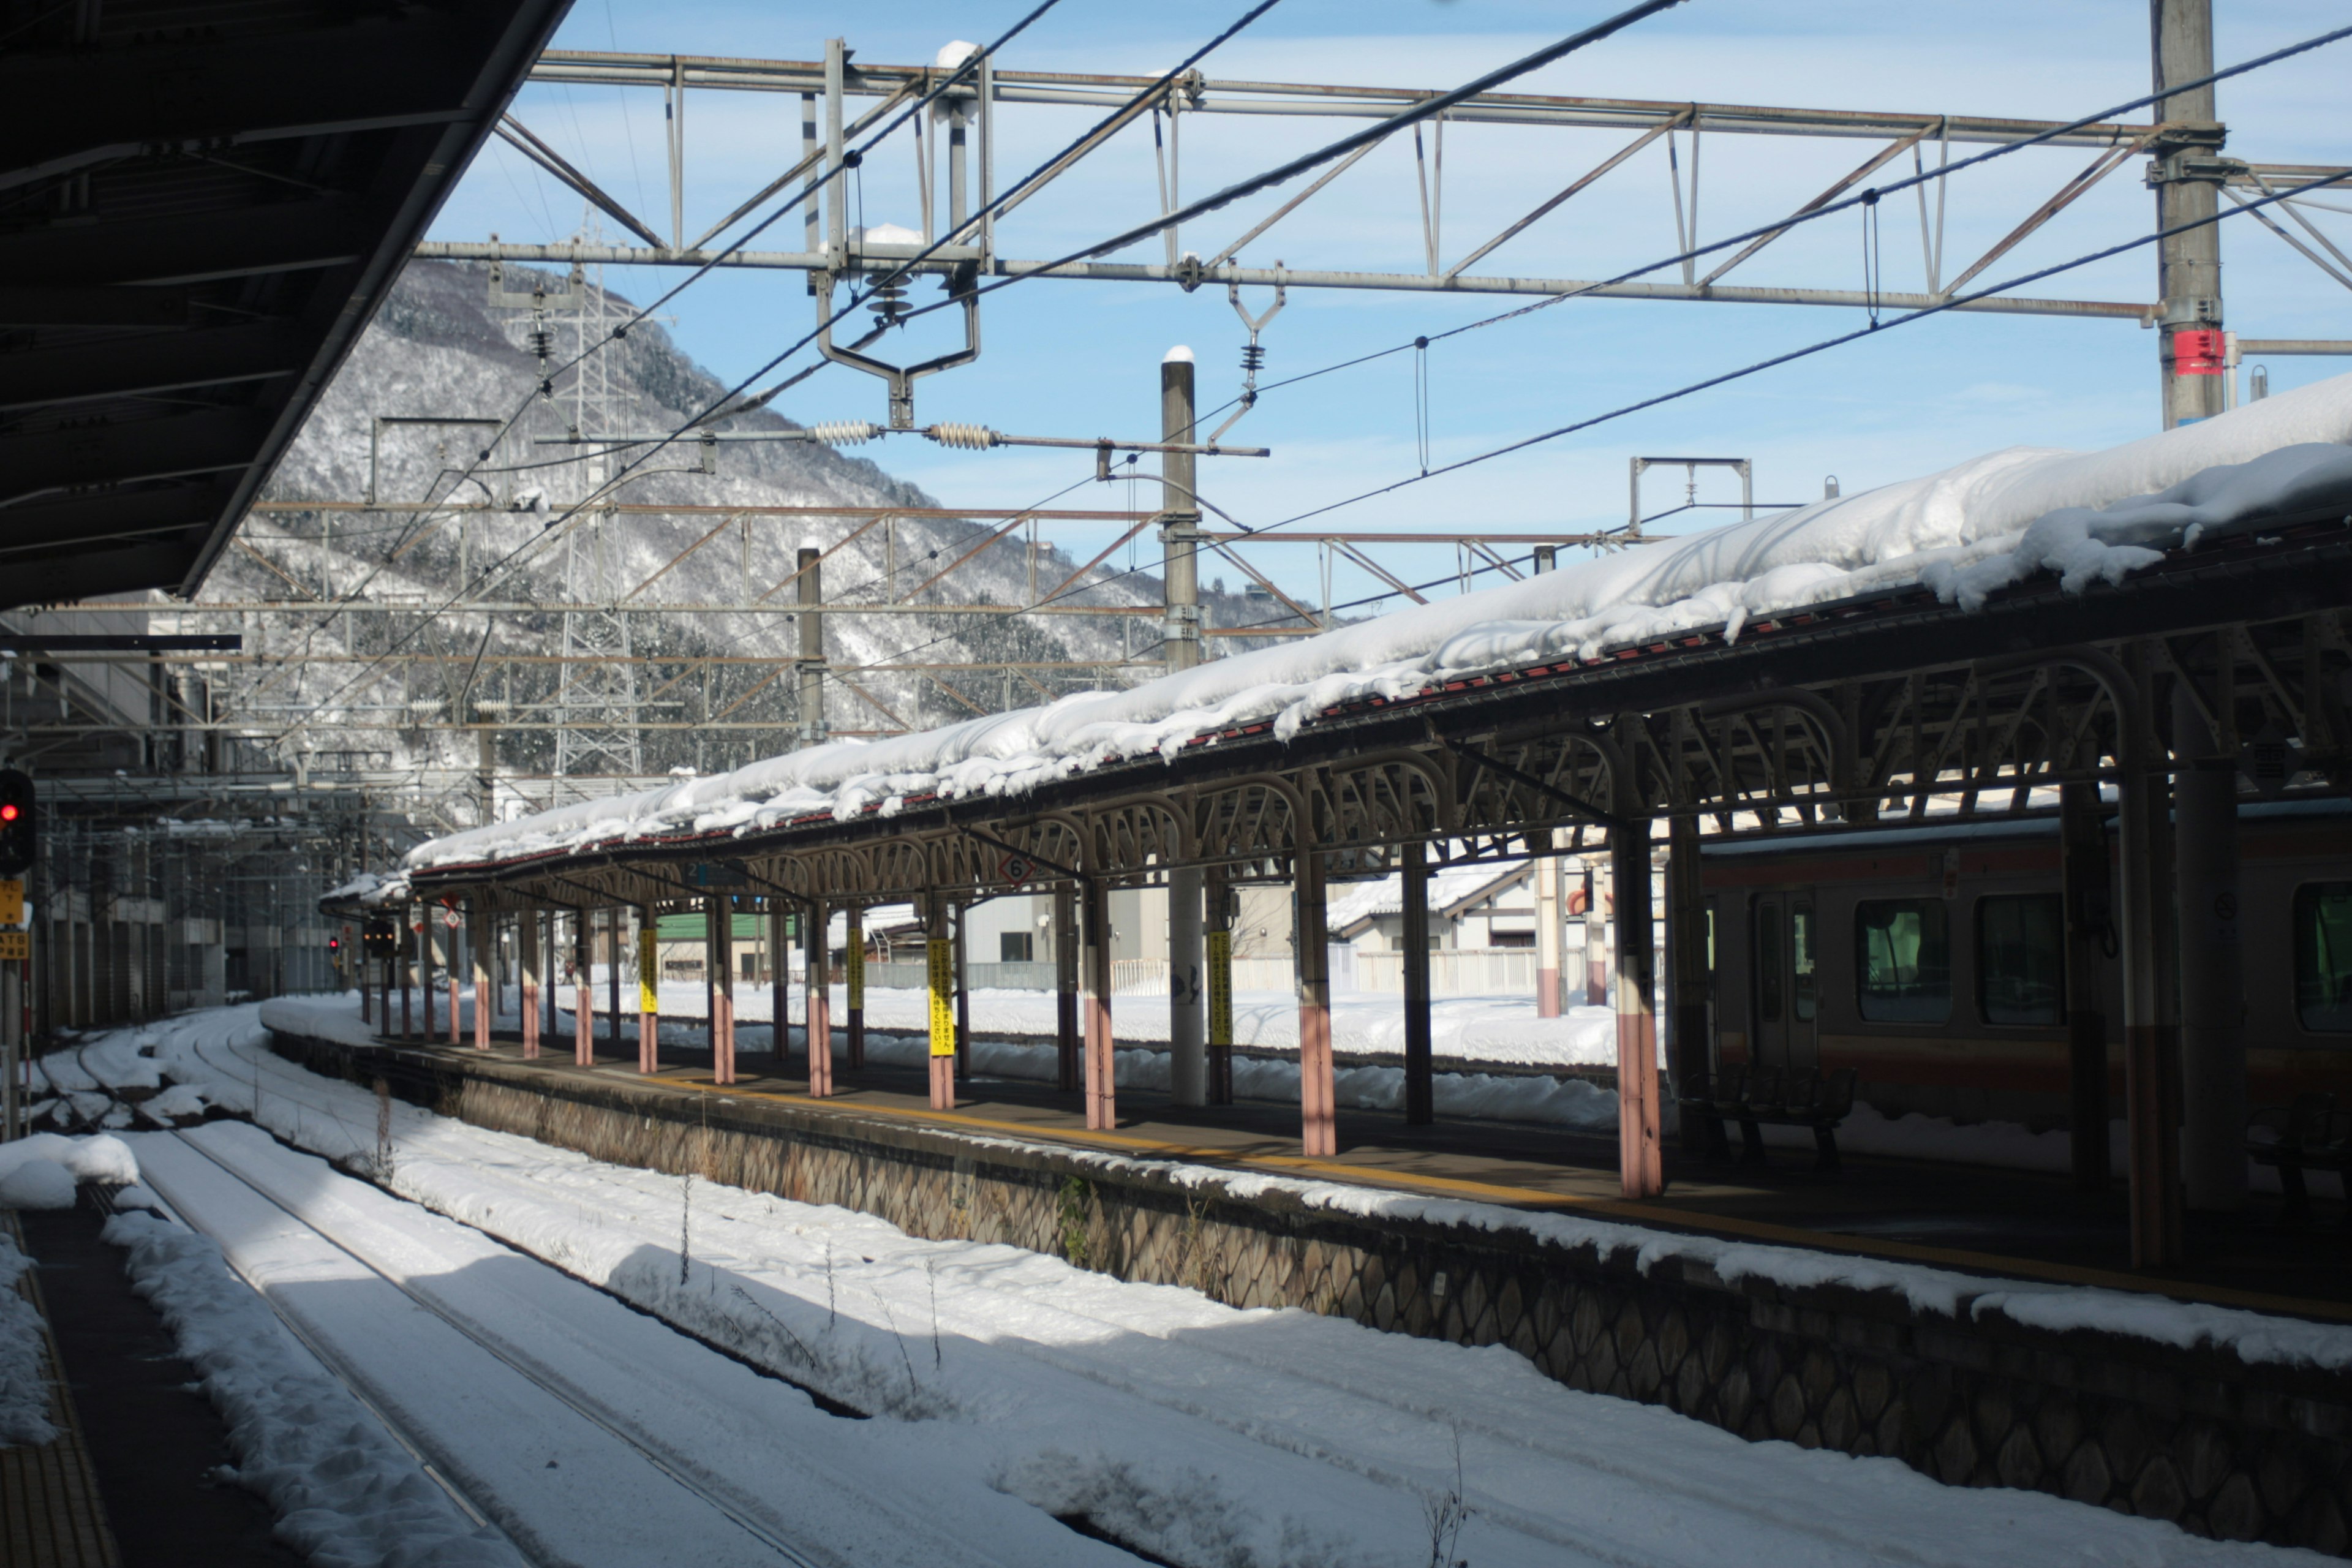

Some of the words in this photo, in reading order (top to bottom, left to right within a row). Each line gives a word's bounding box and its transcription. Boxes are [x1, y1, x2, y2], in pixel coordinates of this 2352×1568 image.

[2254, 743, 2285, 778] 雪
[688, 862, 698, 877] 2
[1010, 859, 1022, 877] 6
